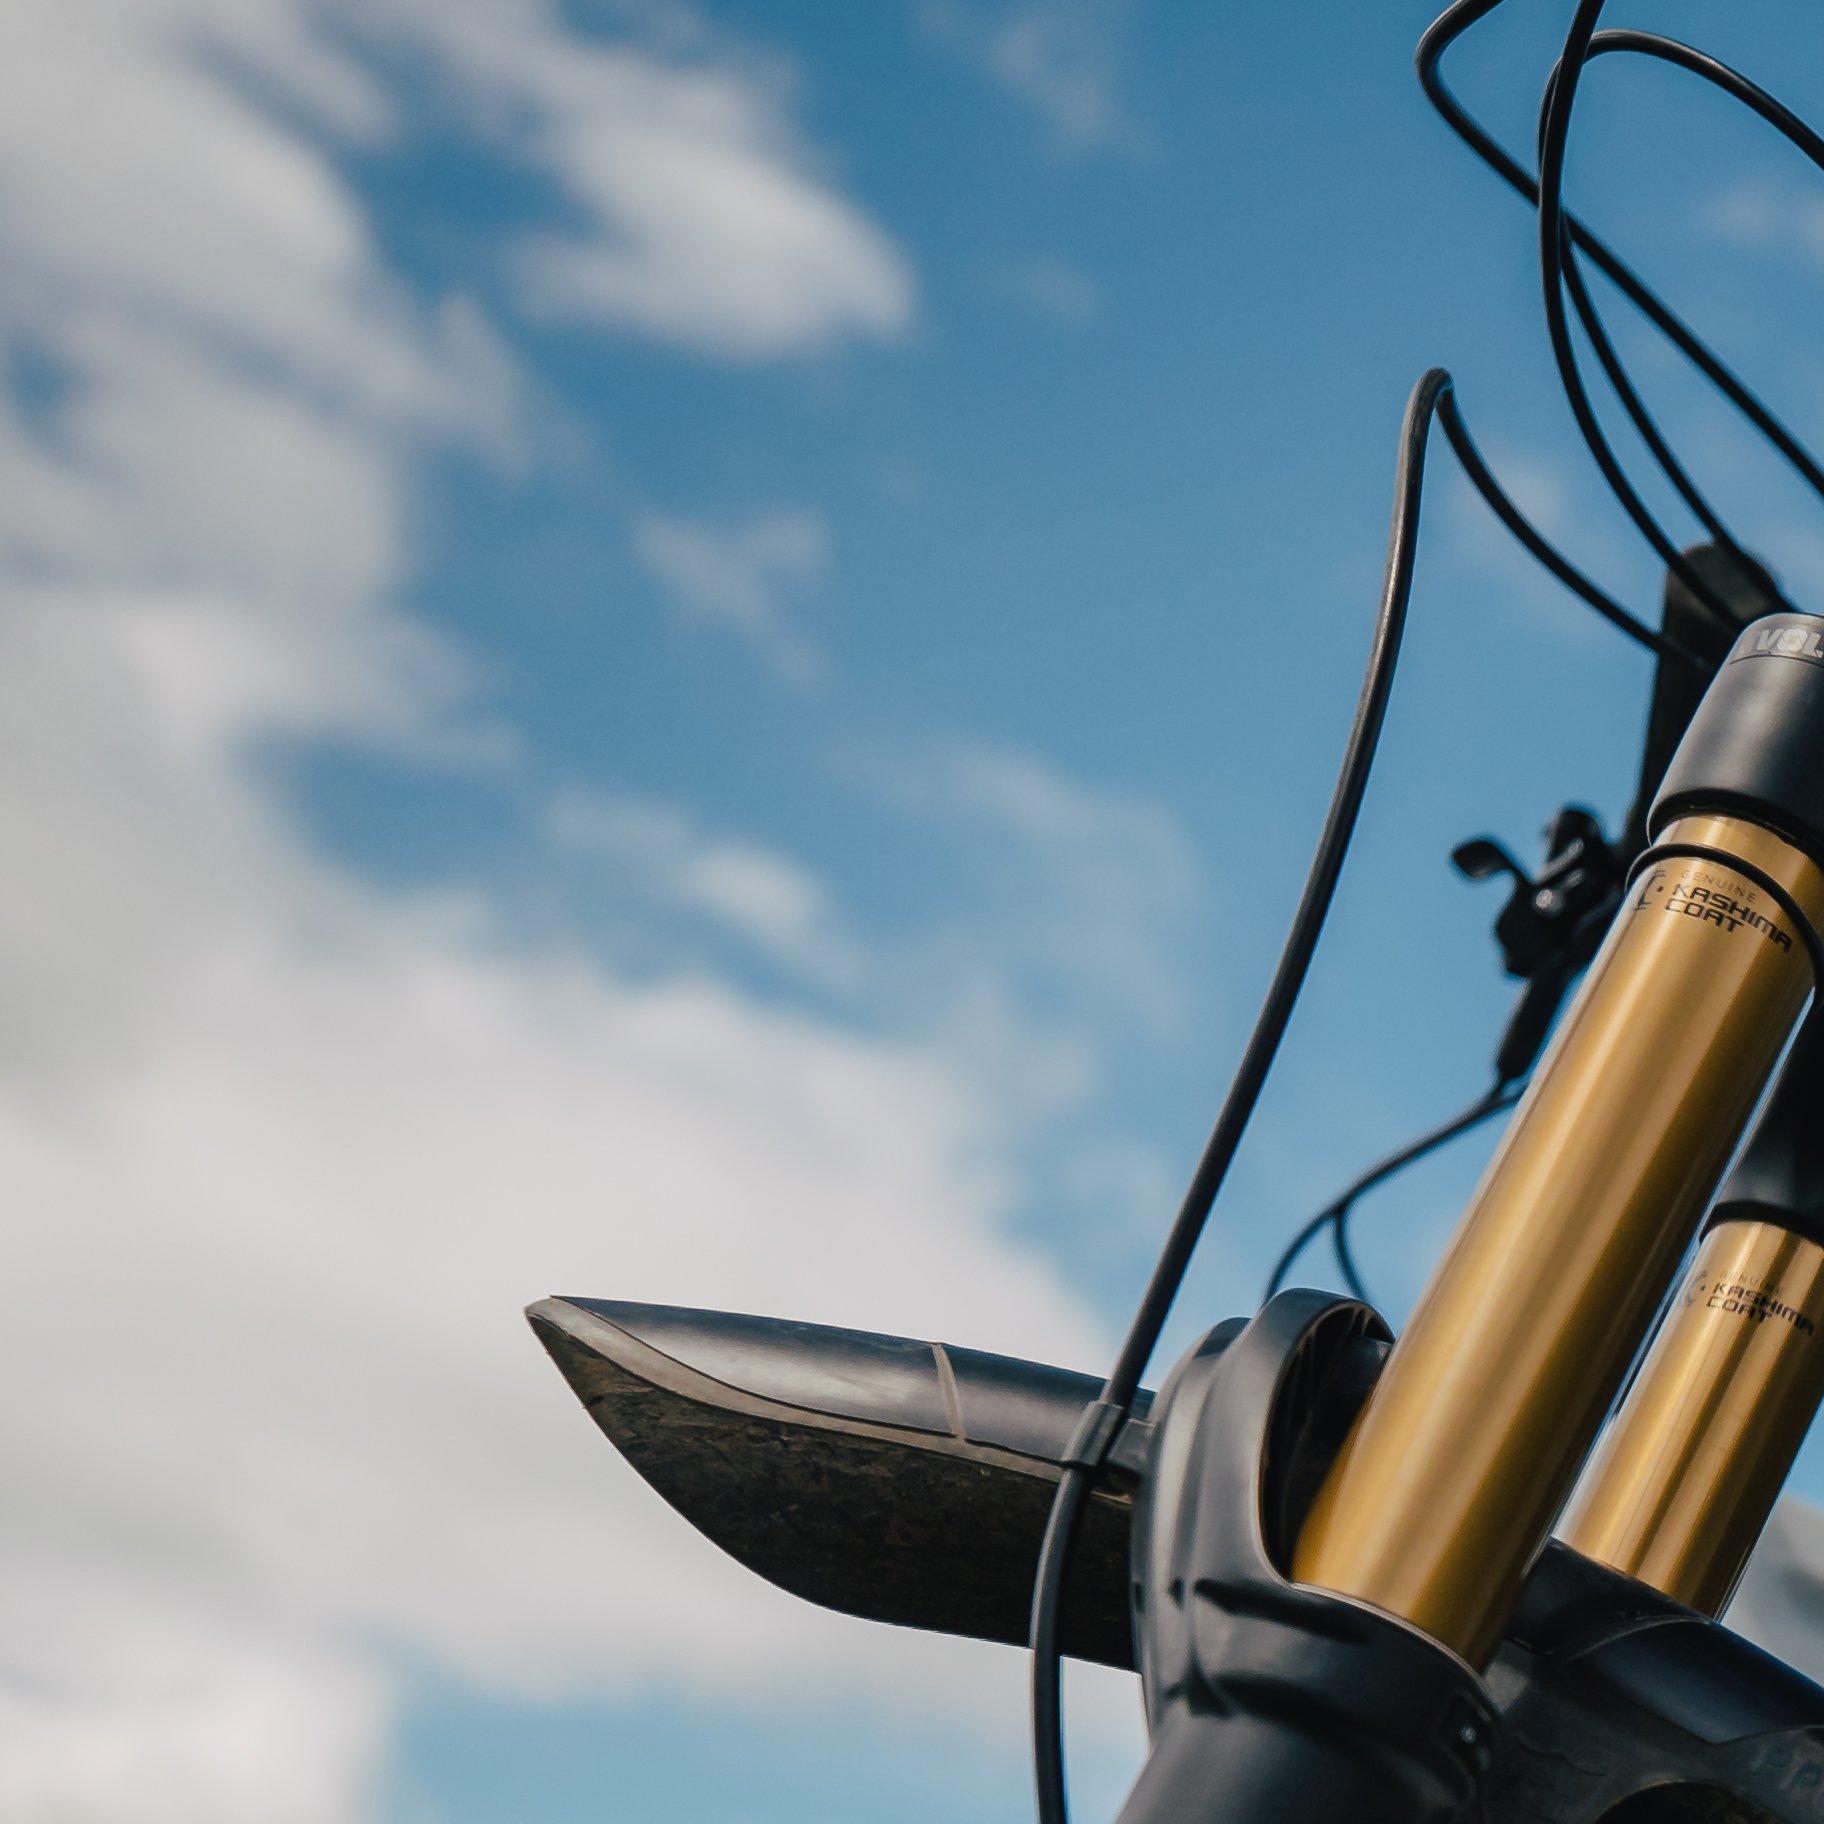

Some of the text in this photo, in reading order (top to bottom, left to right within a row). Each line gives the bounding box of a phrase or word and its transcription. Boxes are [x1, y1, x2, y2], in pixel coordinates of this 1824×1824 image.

[1682, 869, 1757, 904] GENUINE
[1665, 898, 1744, 934] COAT
[1672, 883, 1793, 953] KASHIMA
